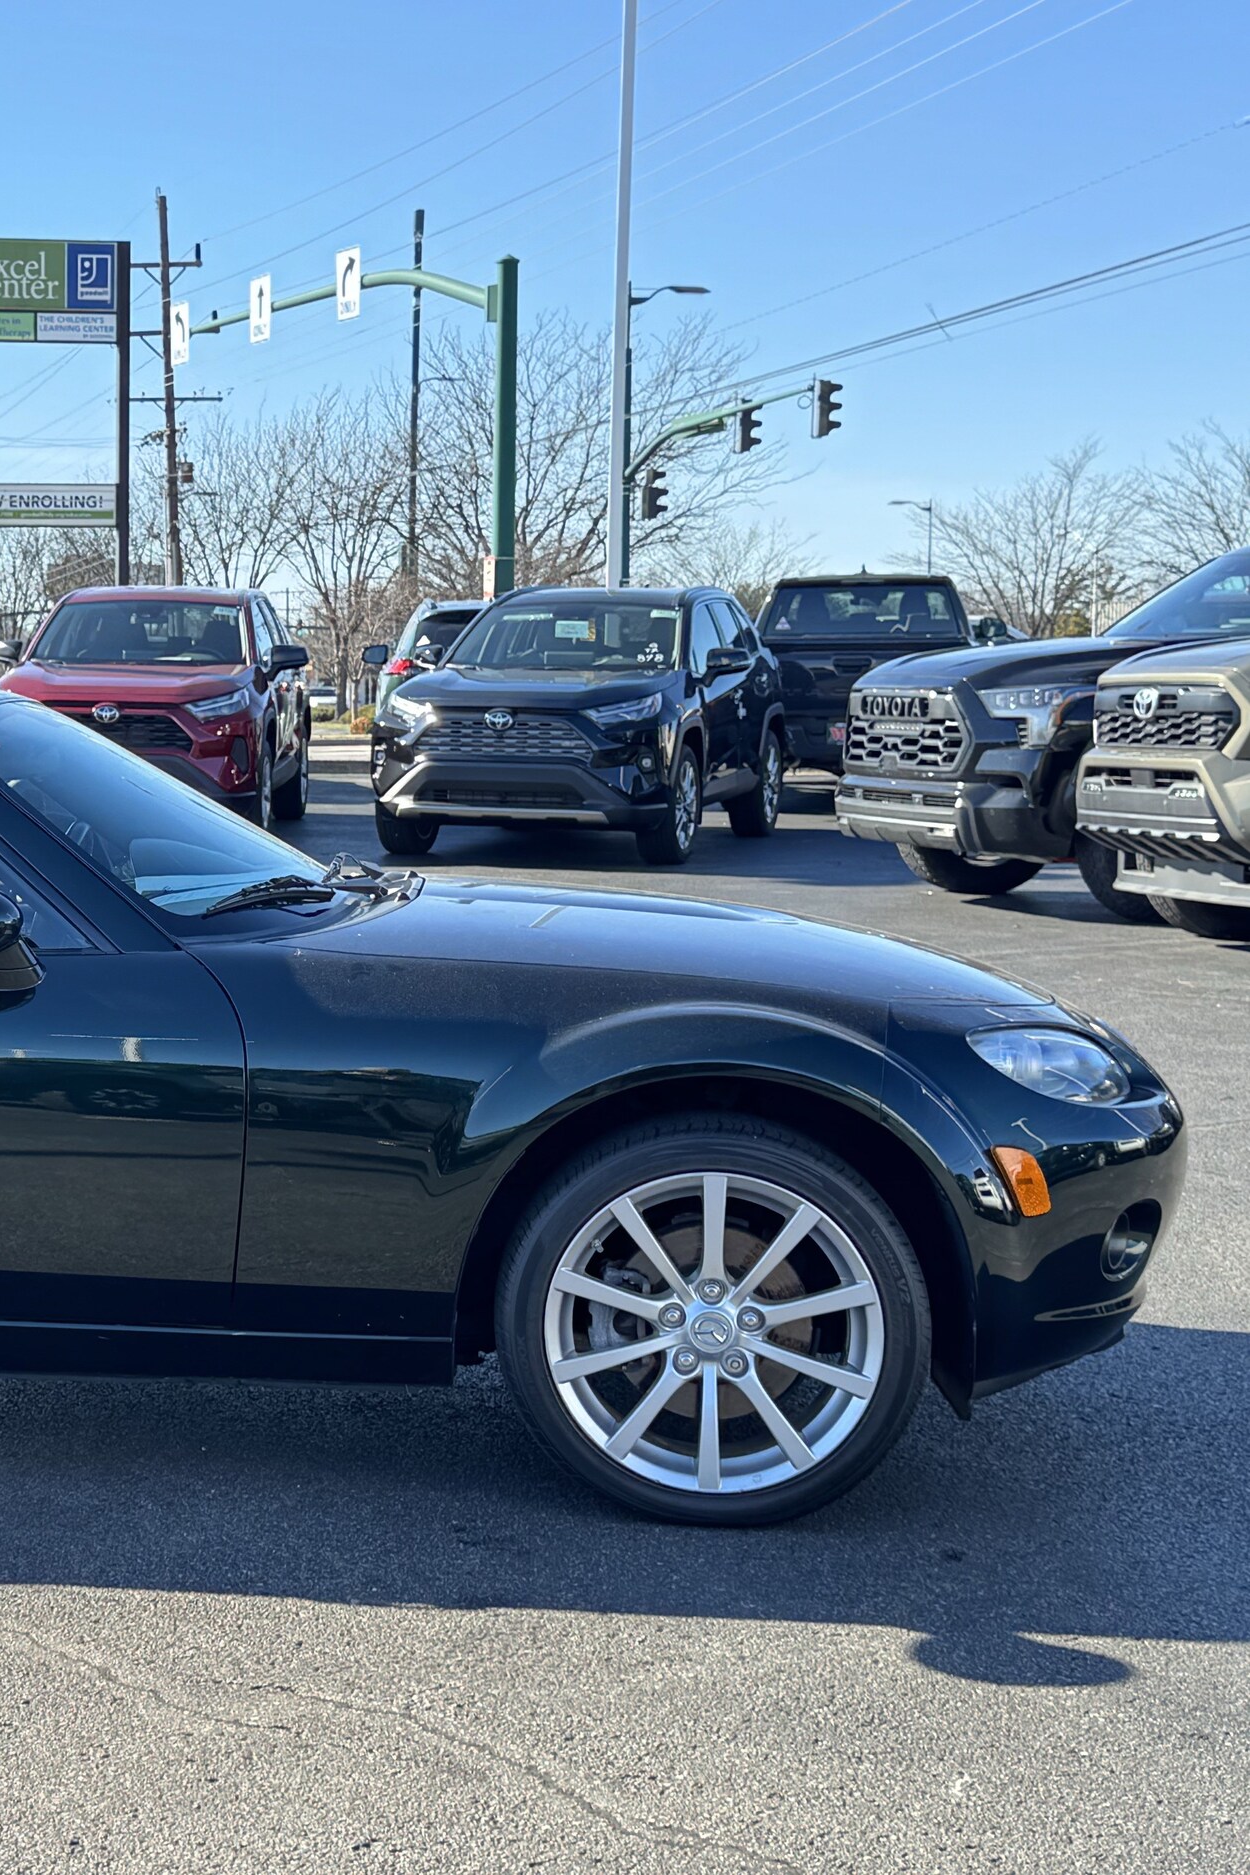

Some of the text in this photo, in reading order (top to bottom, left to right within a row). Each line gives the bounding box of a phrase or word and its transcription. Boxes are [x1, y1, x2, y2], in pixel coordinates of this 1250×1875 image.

[39, 315, 104, 324] THE CHILDREN'S
[39, 324, 114, 334] LEARNING CENTER
[9, 495, 104, 508] ENROLLING!
[866, 696, 921, 718] TOYOTA
